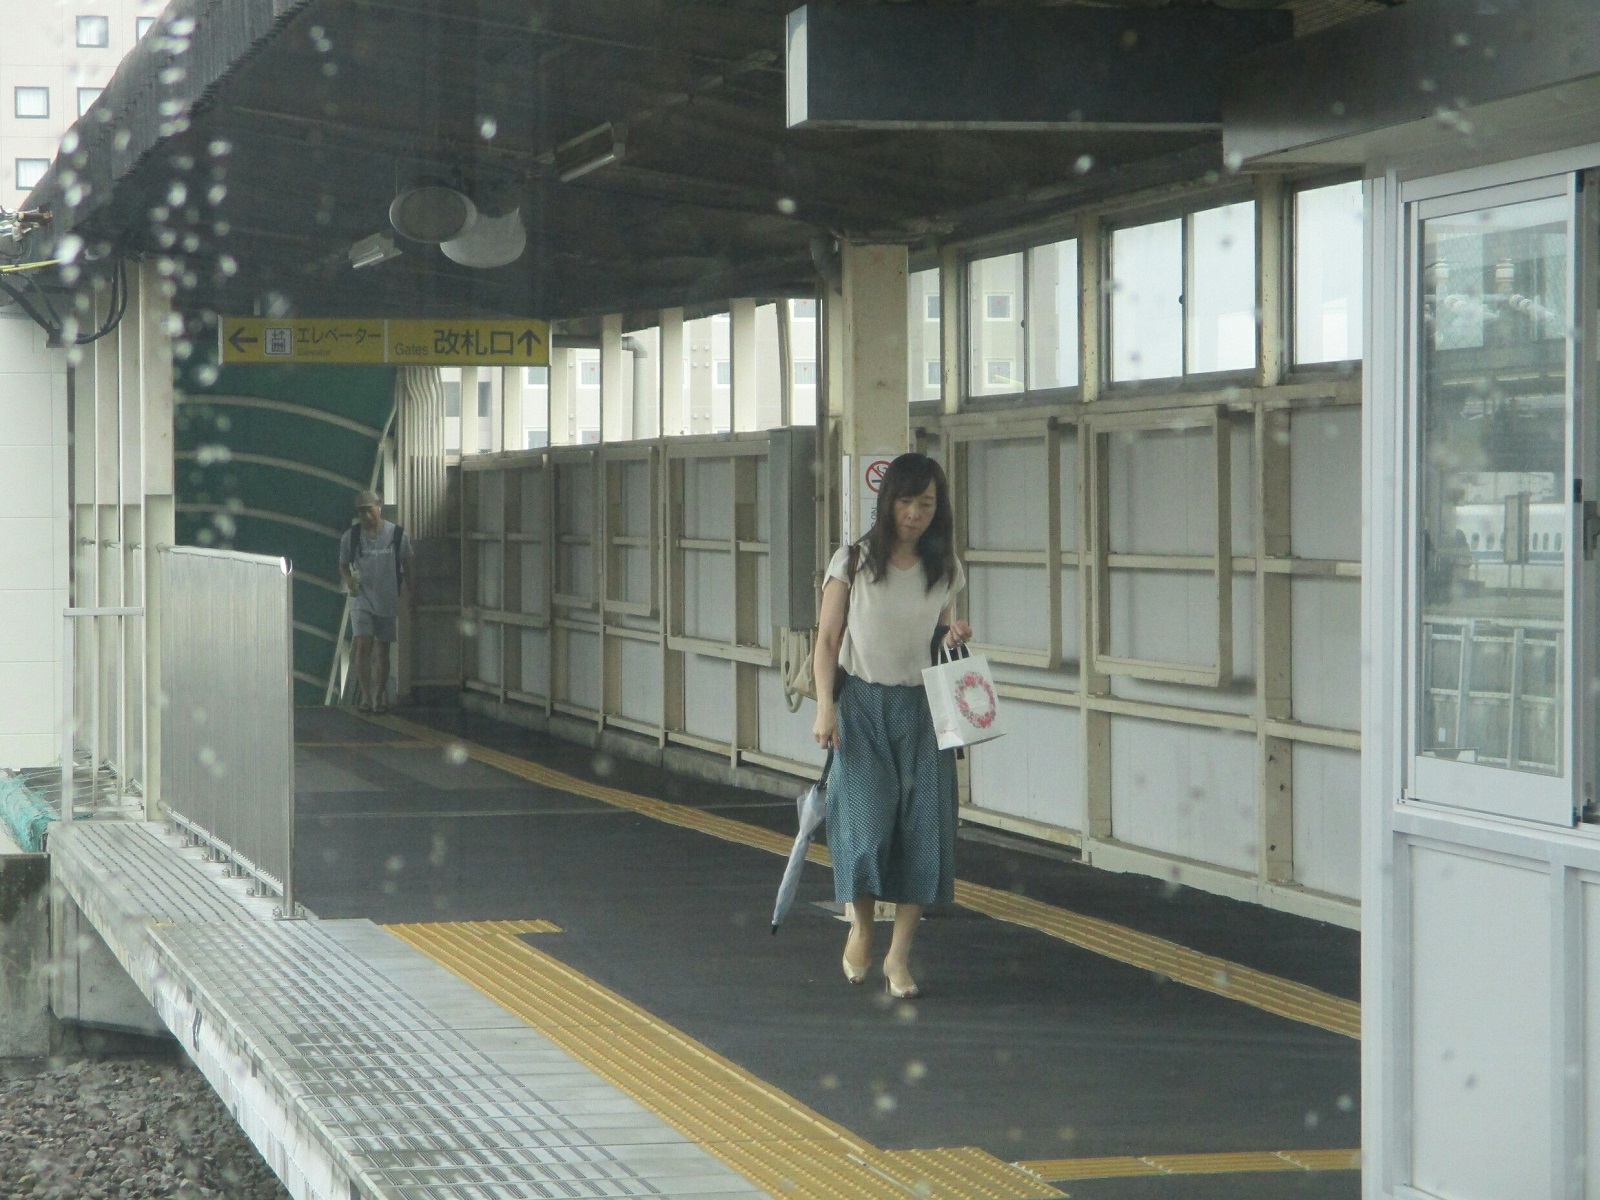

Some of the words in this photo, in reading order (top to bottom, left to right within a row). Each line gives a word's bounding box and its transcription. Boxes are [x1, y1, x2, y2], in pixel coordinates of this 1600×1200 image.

[297, 328, 382, 344] エレベーター
[434, 329, 514, 355] 改札口
[395, 342, 428, 356] Gates
